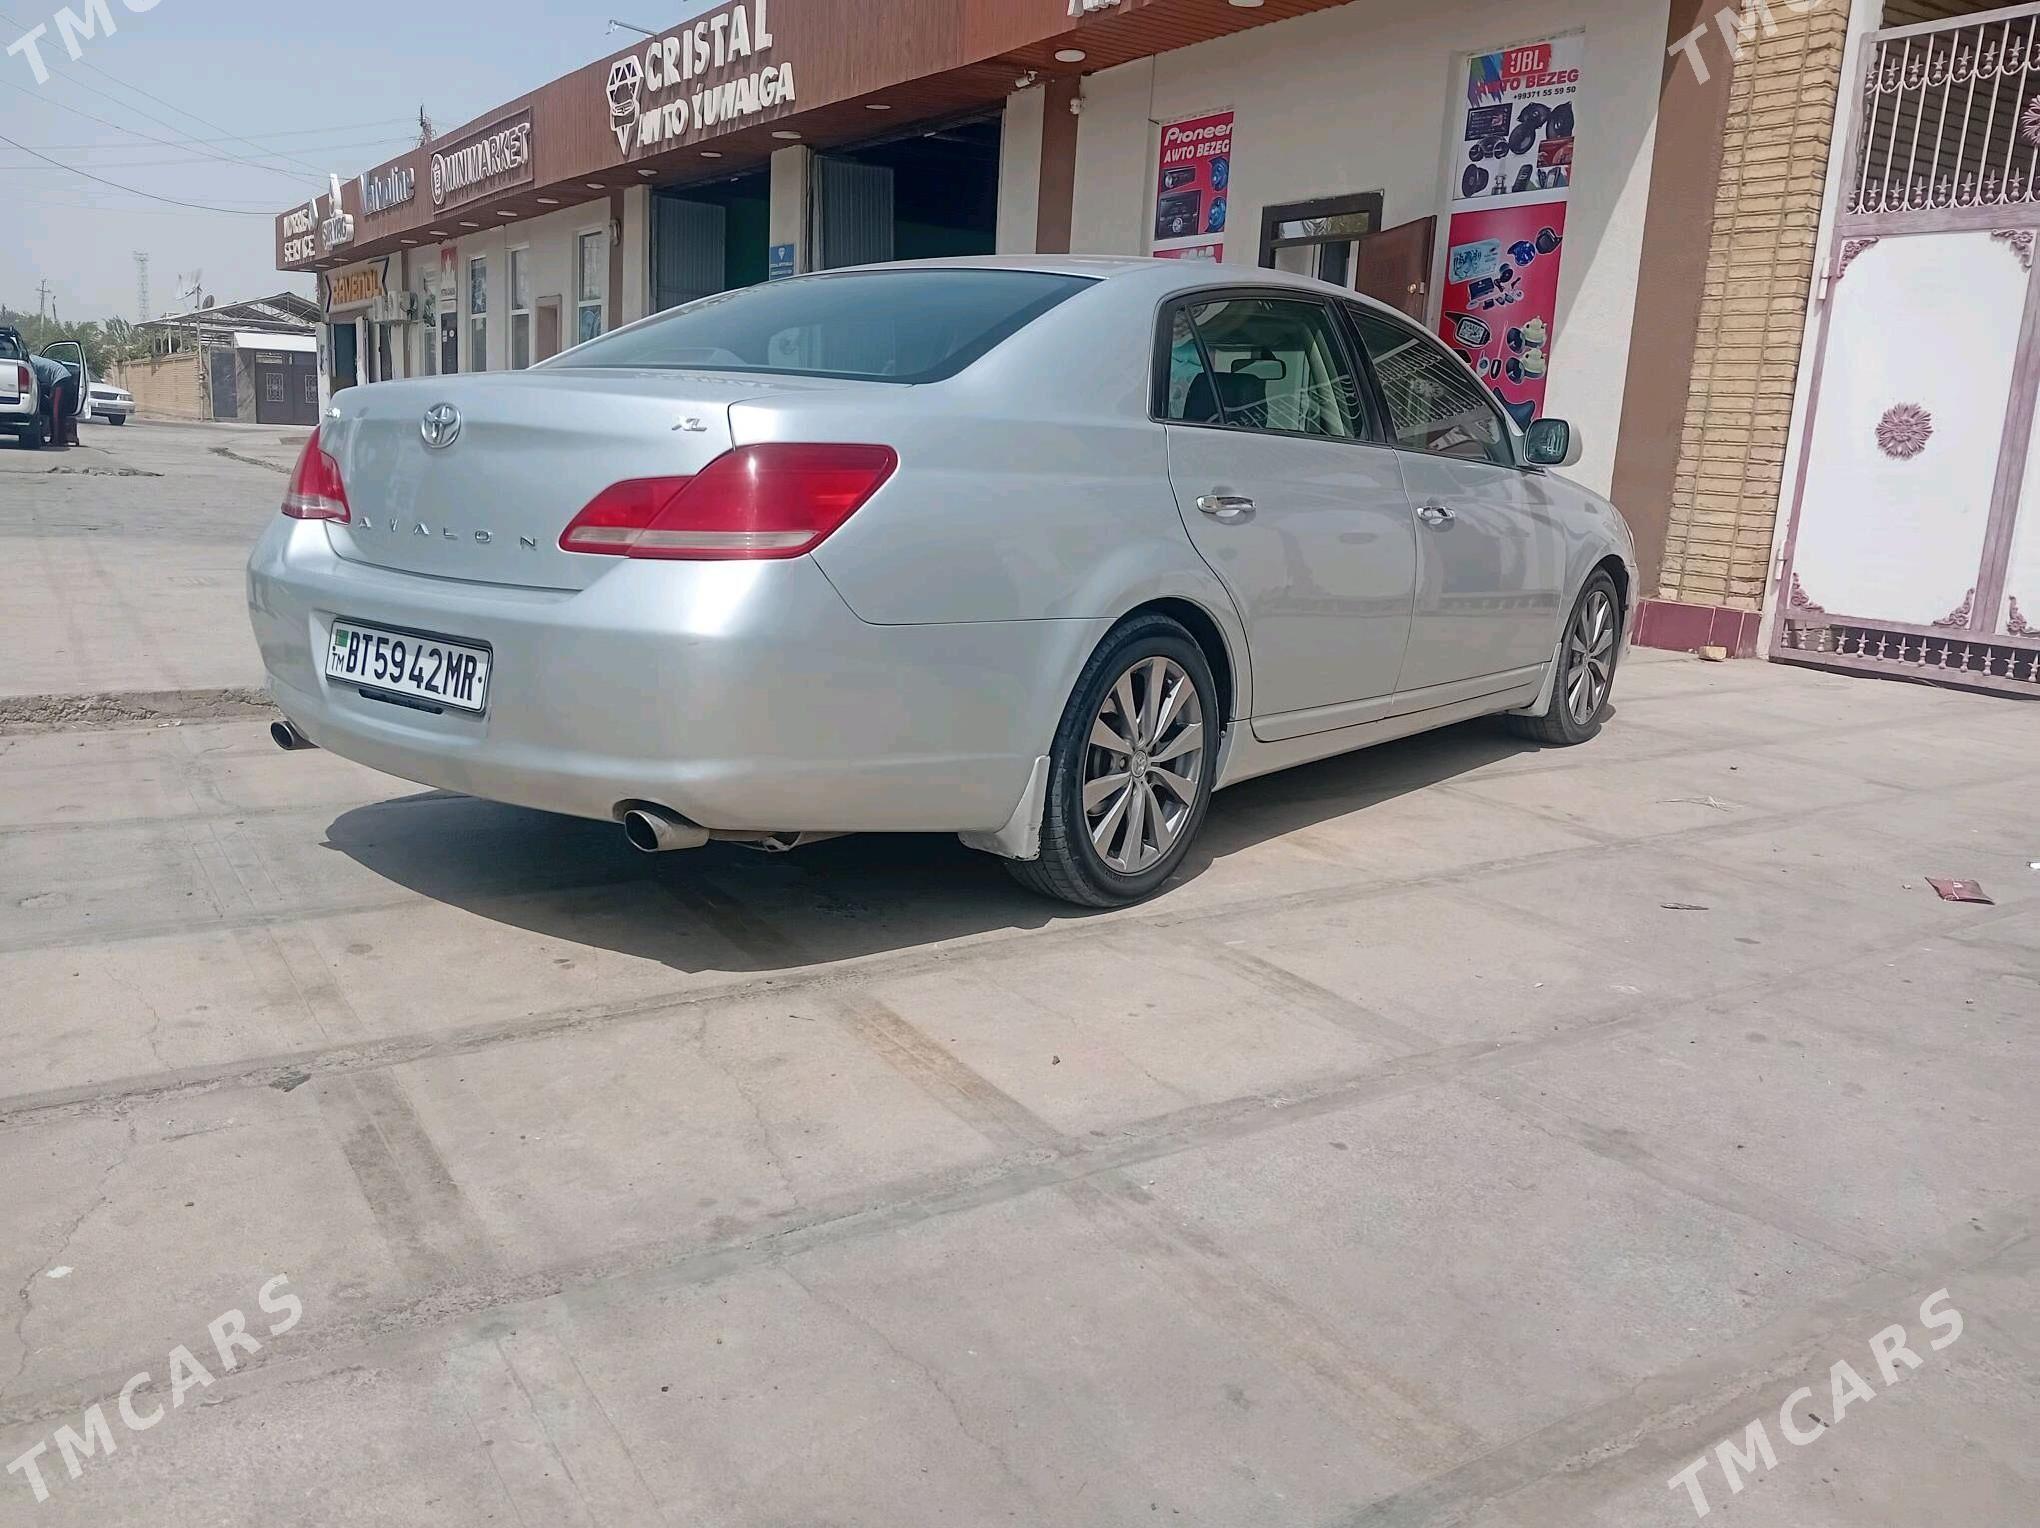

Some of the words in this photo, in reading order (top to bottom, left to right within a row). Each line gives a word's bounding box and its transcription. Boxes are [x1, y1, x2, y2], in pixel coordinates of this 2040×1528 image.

[645, 0, 773, 92] CRISTAL
[1510, 49, 1544, 74] JBL
[1525, 69, 1579, 88] BEZEG
[1513, 91, 1541, 101] +99371
[1543, 88, 1553, 97] 55
[1554, 87, 1564, 95] 59
[1566, 86, 1576, 94] 50
[637, 99, 689, 148] AWTO
[1164, 122, 1234, 146] Pioneer
[1163, 145, 1195, 163] AWTO
[1196, 139, 1230, 157] BEZEG
[359, 516, 537, 550] AVALON
[331, 652, 345, 673] TM
